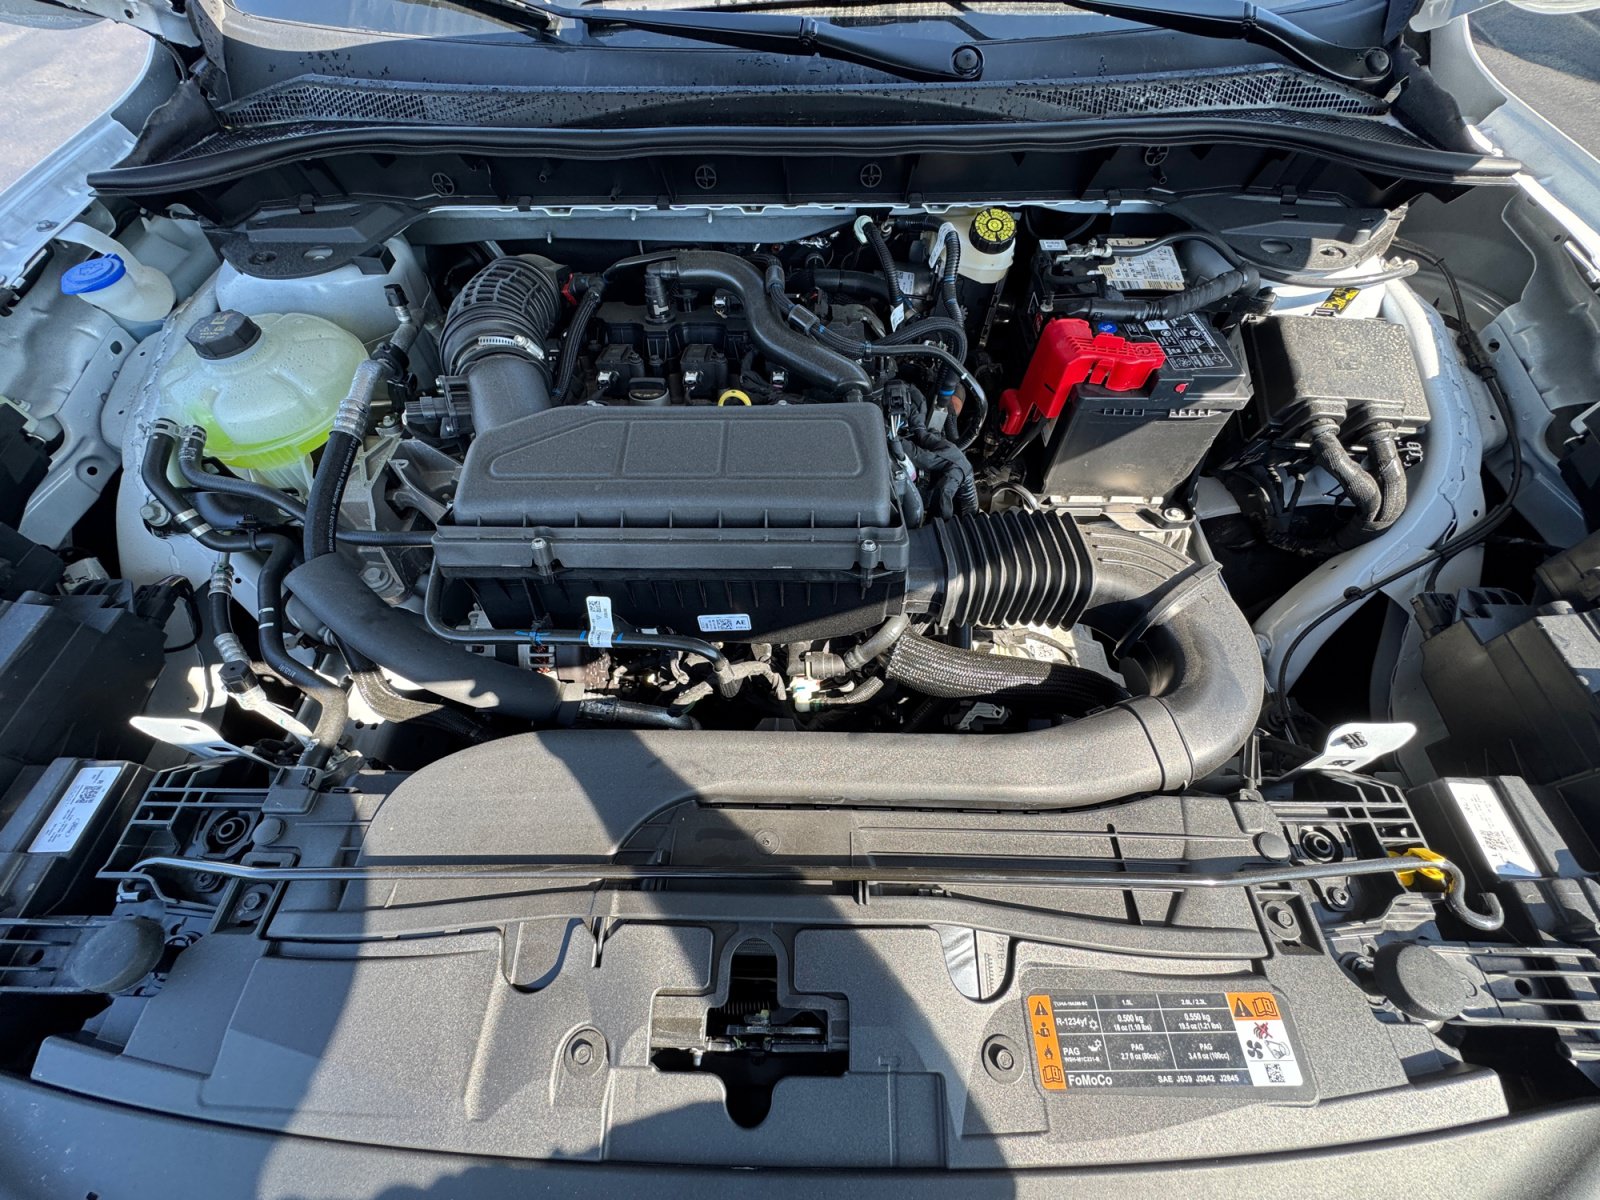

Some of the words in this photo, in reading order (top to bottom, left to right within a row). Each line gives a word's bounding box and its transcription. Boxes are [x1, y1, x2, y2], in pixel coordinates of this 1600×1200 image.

[1117, 1014, 1135, 1022] 0.500
[1134, 1014, 1144, 1023] kg
[1183, 1013, 1202, 1021] 0.550
[1201, 1012, 1211, 1022] kg
[1056, 1017, 1088, 1027] R-1234yf
[1062, 1047, 1080, 1055] PAG
[1130, 1043, 1144, 1051] PAG
[1067, 1074, 1113, 1086] FoMoCo
[1157, 1074, 1174, 1083] SAE
